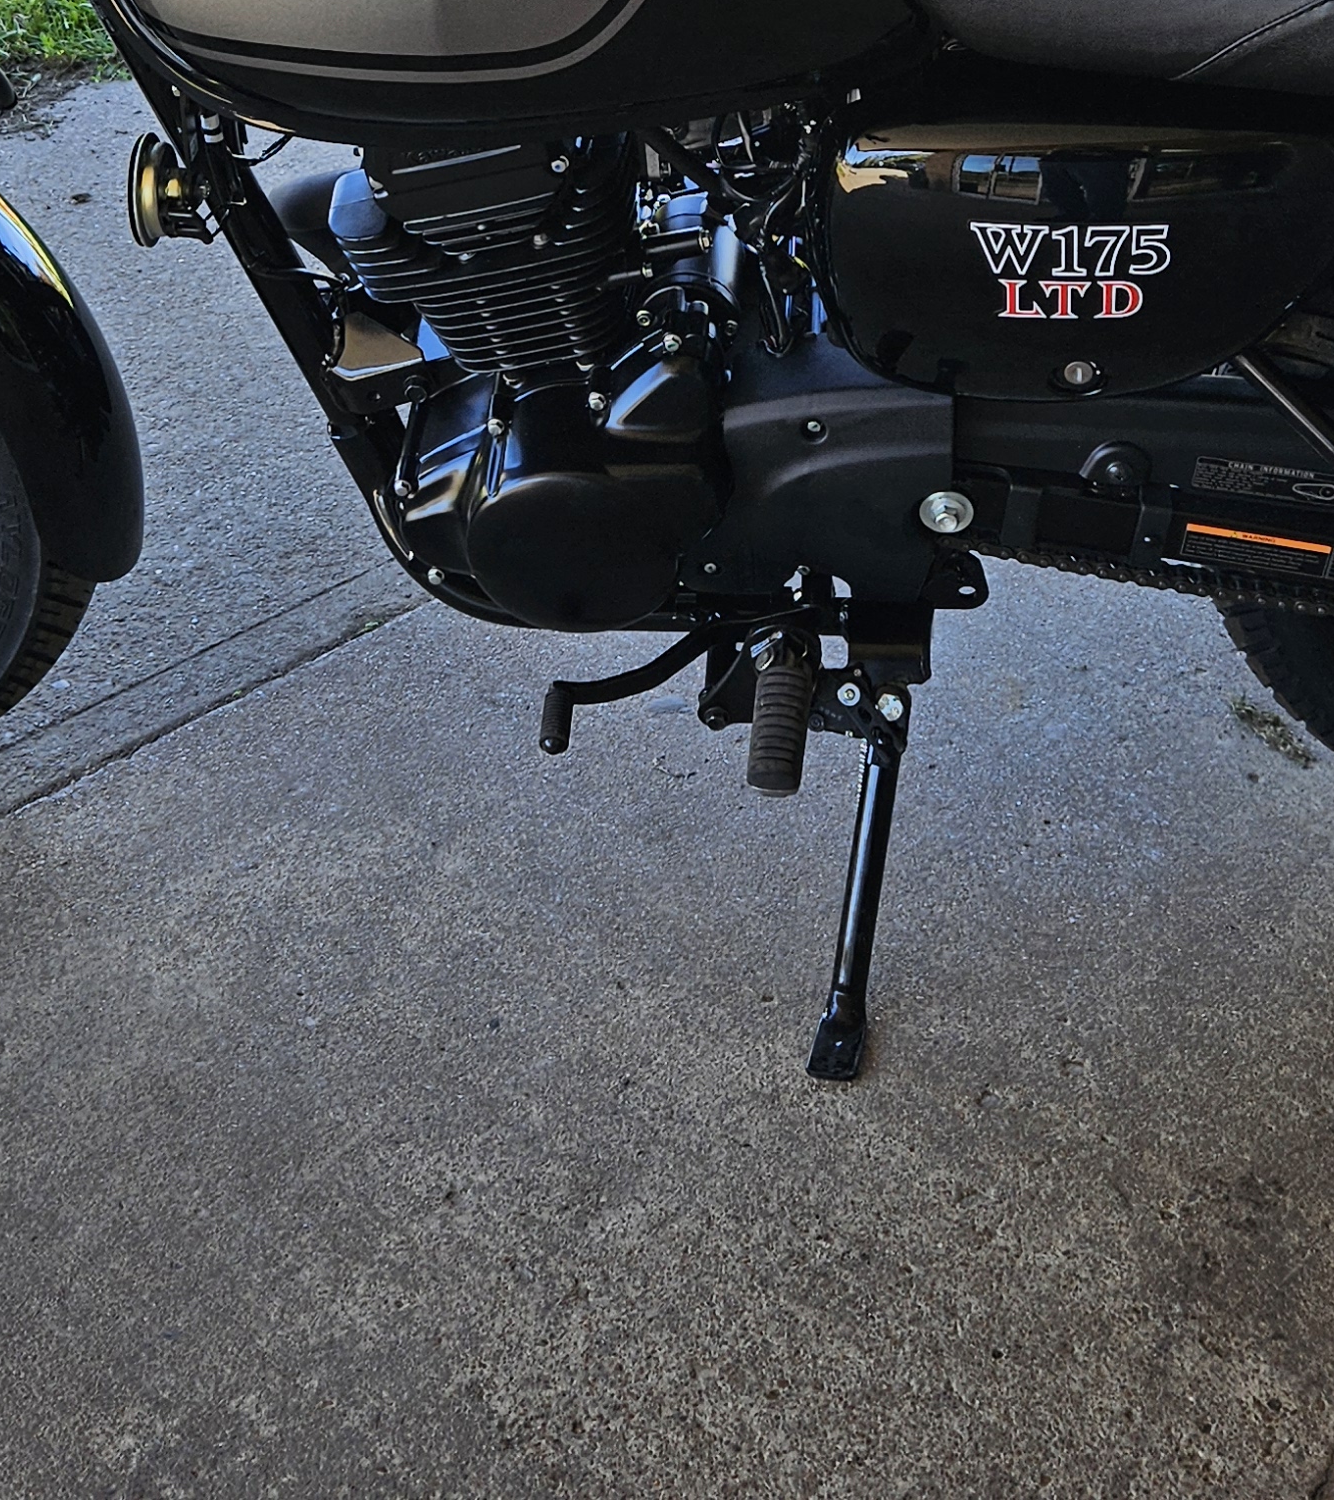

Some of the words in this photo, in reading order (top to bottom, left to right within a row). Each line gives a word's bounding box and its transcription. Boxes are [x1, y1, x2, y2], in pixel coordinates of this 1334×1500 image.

[970, 221, 1171, 277] W175
[997, 278, 1143, 319] LTD
[1227, 461, 1254, 472] CHAIN
[1259, 466, 1316, 480] INFORMATION
